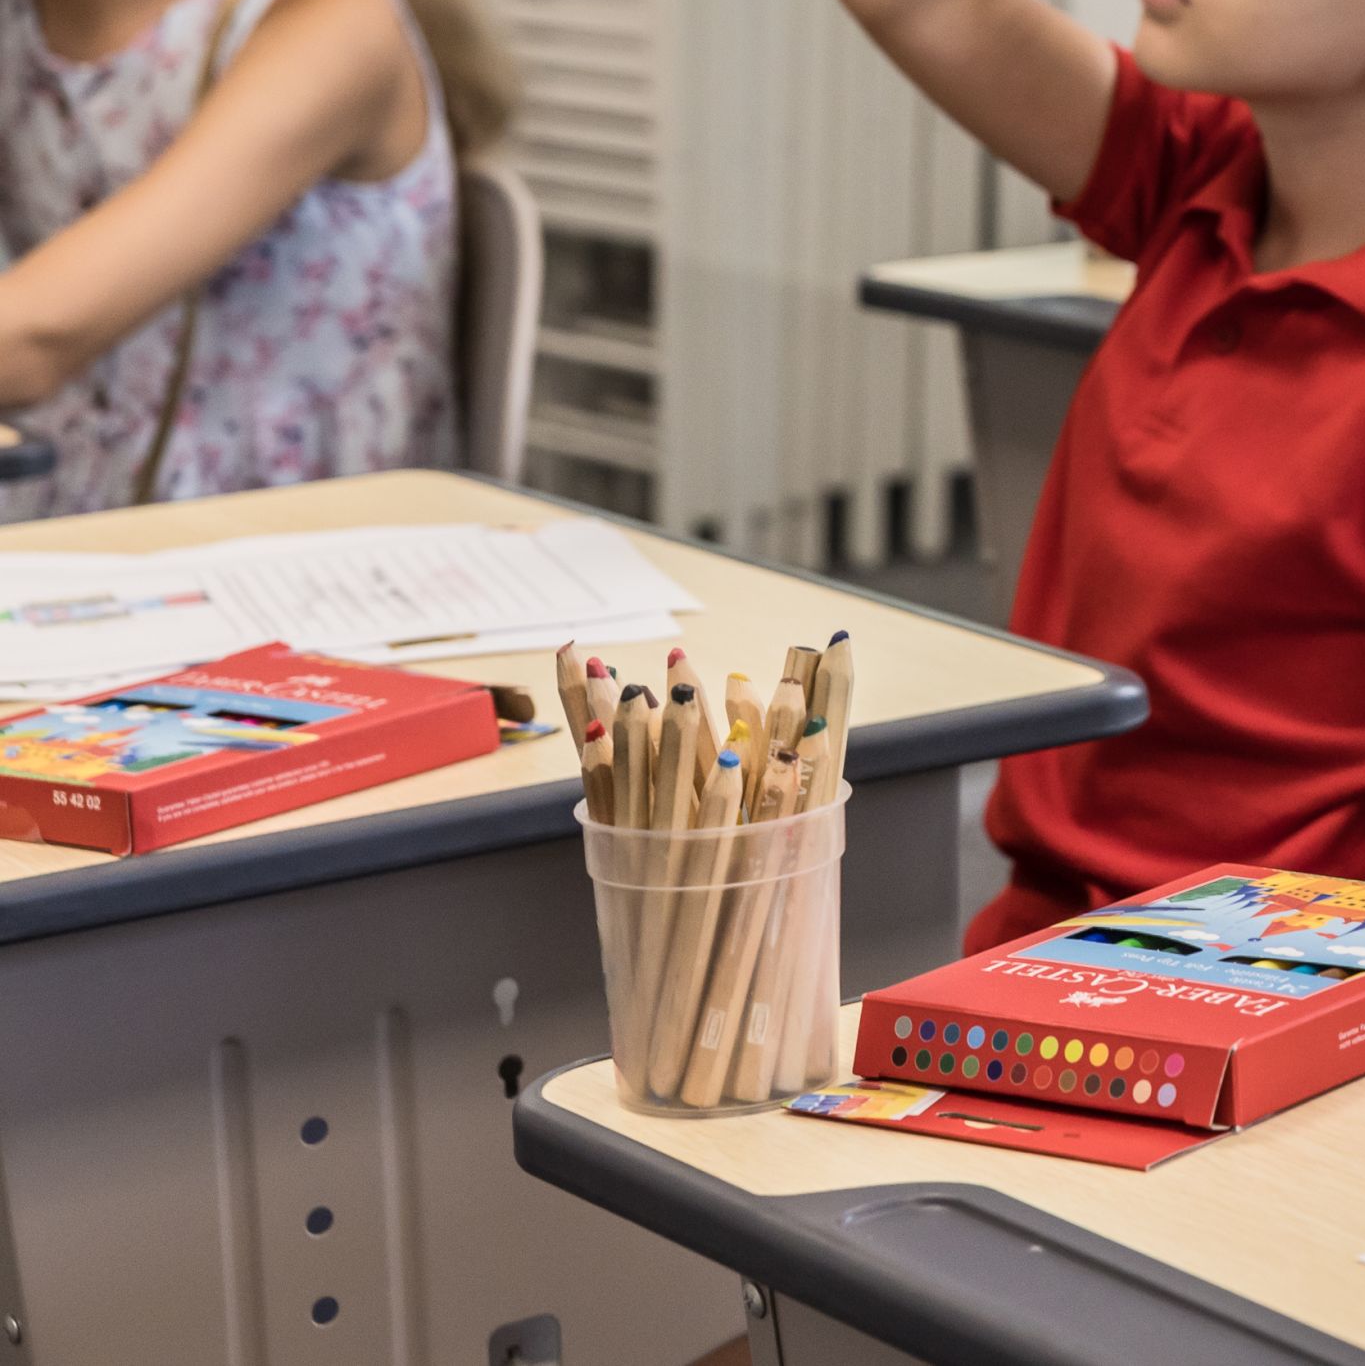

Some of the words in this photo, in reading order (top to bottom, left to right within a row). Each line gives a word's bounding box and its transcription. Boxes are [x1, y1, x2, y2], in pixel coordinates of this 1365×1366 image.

[53, 789, 68, 806] 55
[70, 792, 85, 809] 42
[86, 794, 101, 811] 02
[981, 960, 1290, 1016] FABER-CASTELL
